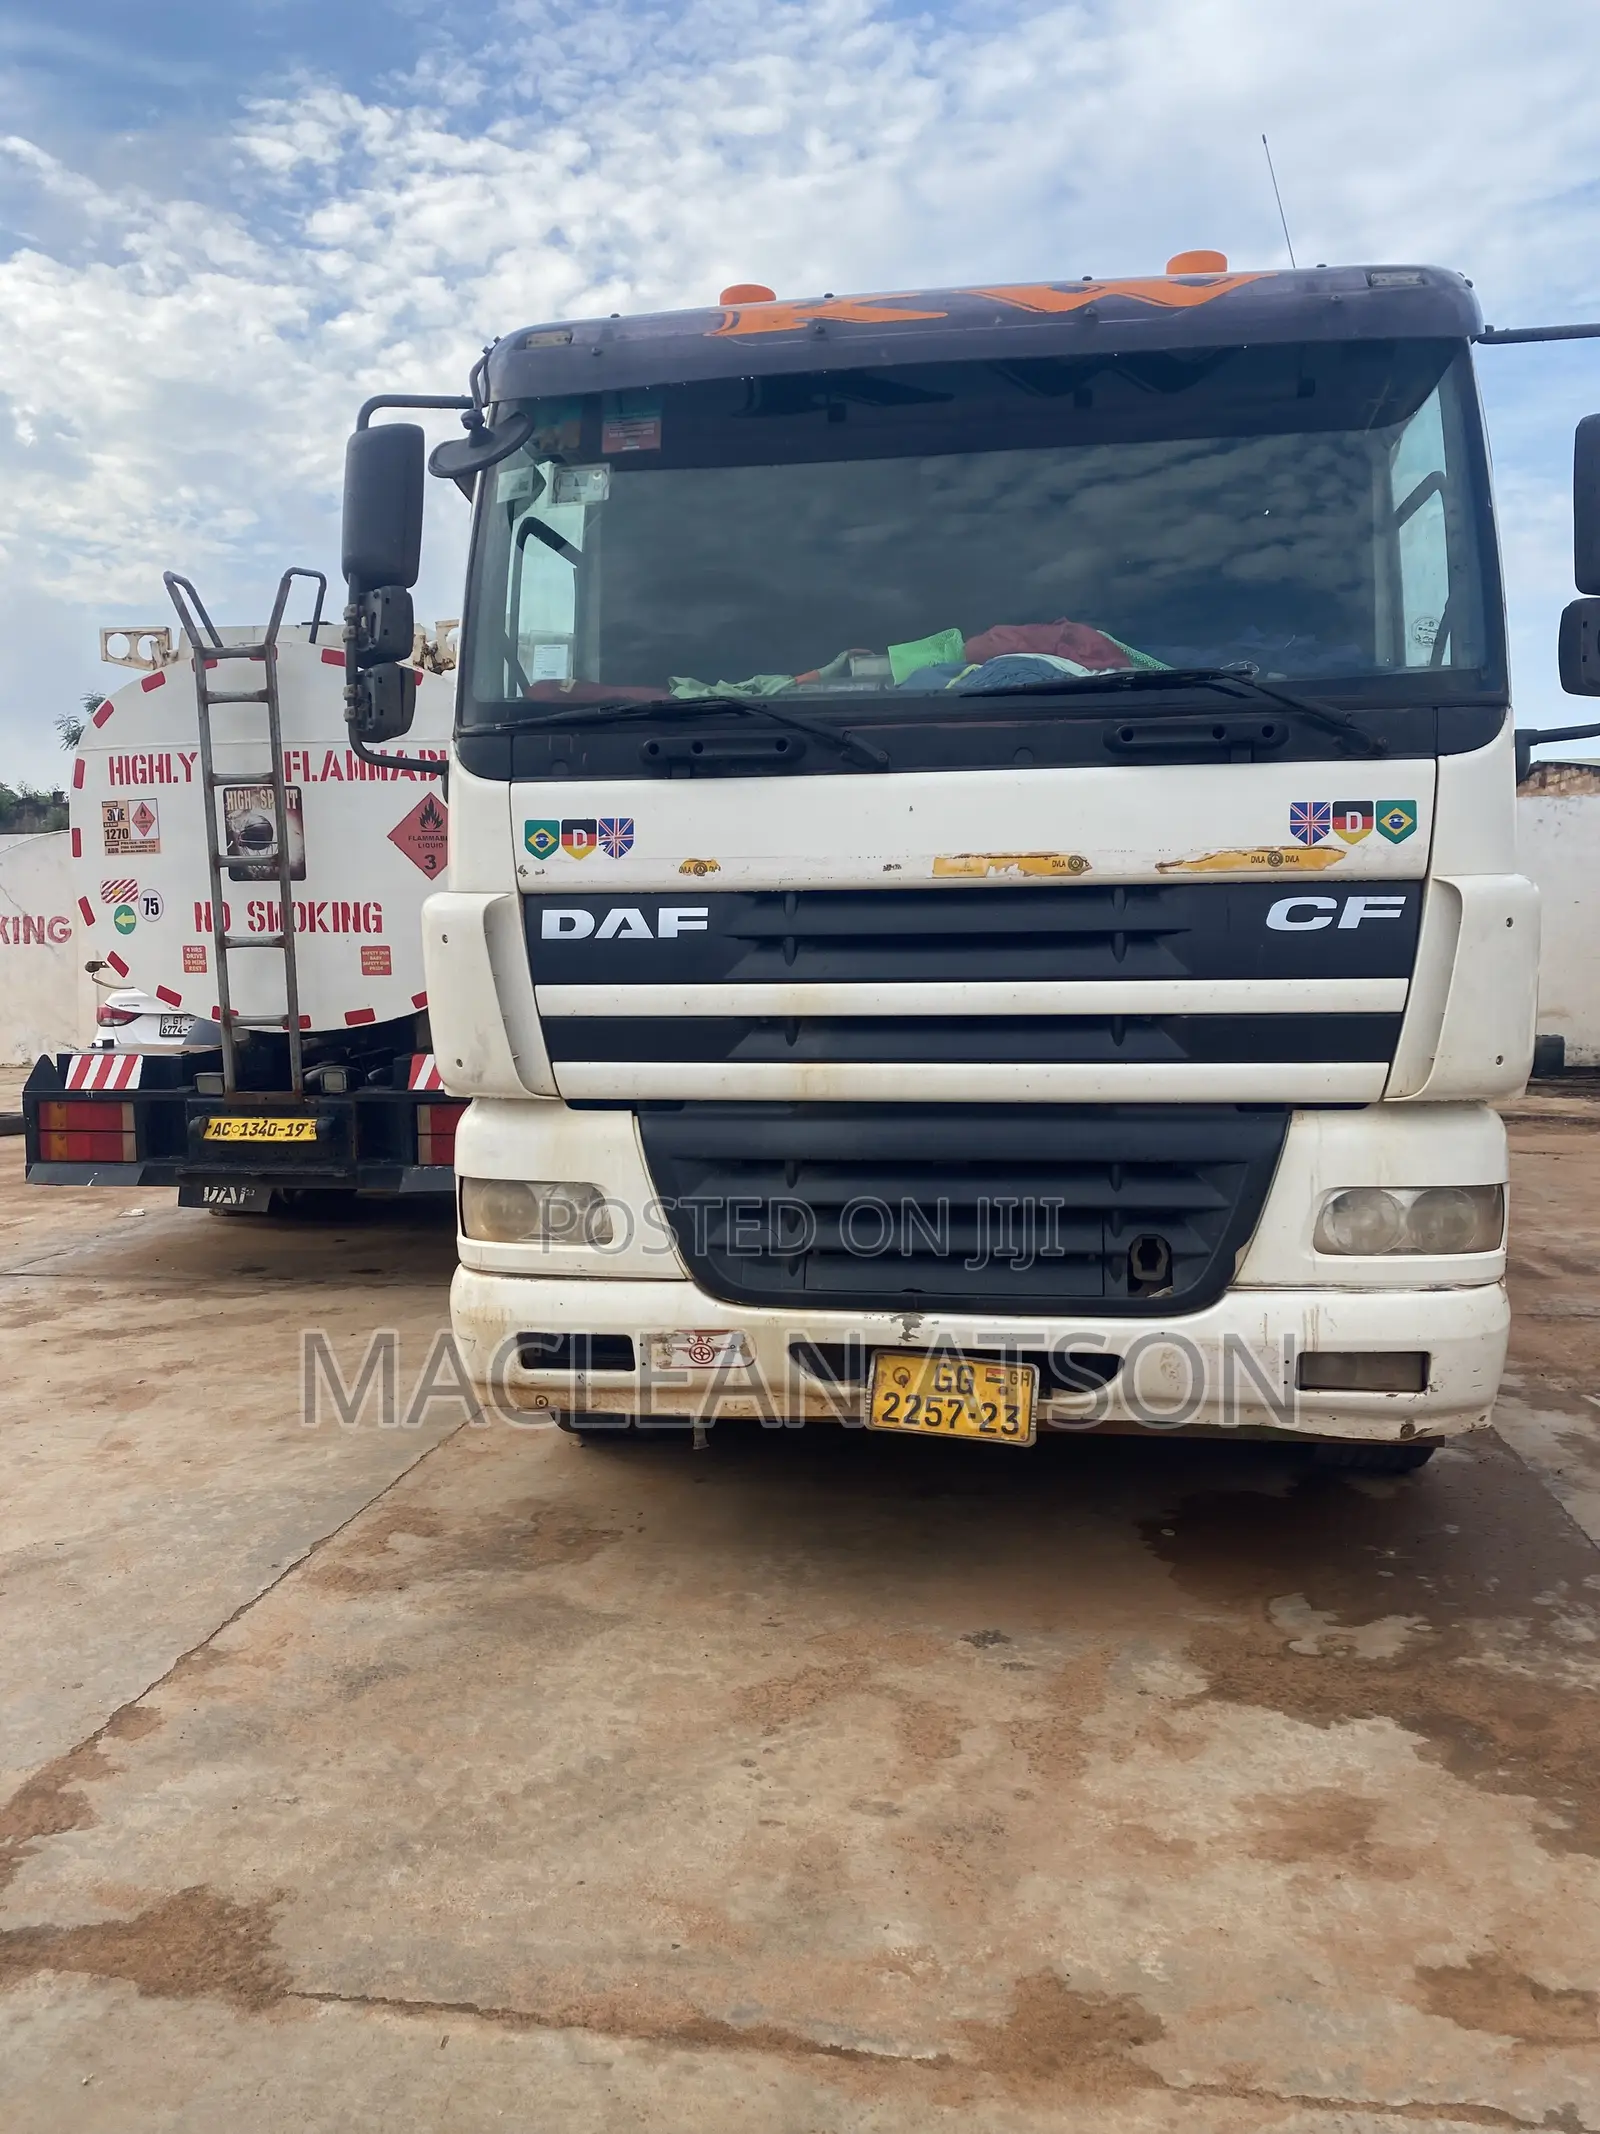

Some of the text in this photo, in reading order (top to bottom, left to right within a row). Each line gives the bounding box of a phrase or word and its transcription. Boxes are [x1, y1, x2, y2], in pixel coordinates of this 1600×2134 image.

[108, 751, 199, 786] HIGHLY
[226, 789, 252, 811] HIGH
[1345, 811, 1363, 833] D
[104, 827, 129, 840] 1270
[424, 854, 437, 870] 3
[142, 897, 160, 916] 75
[1265, 896, 1407, 932] CF
[541, 907, 709, 940] DAF
[212, 1122, 232, 1137] AC
[686, 1335, 714, 1345] DAF
[934, 1363, 1030, 1395] GG GH
[881, 1391, 1021, 1435] 2257-23
